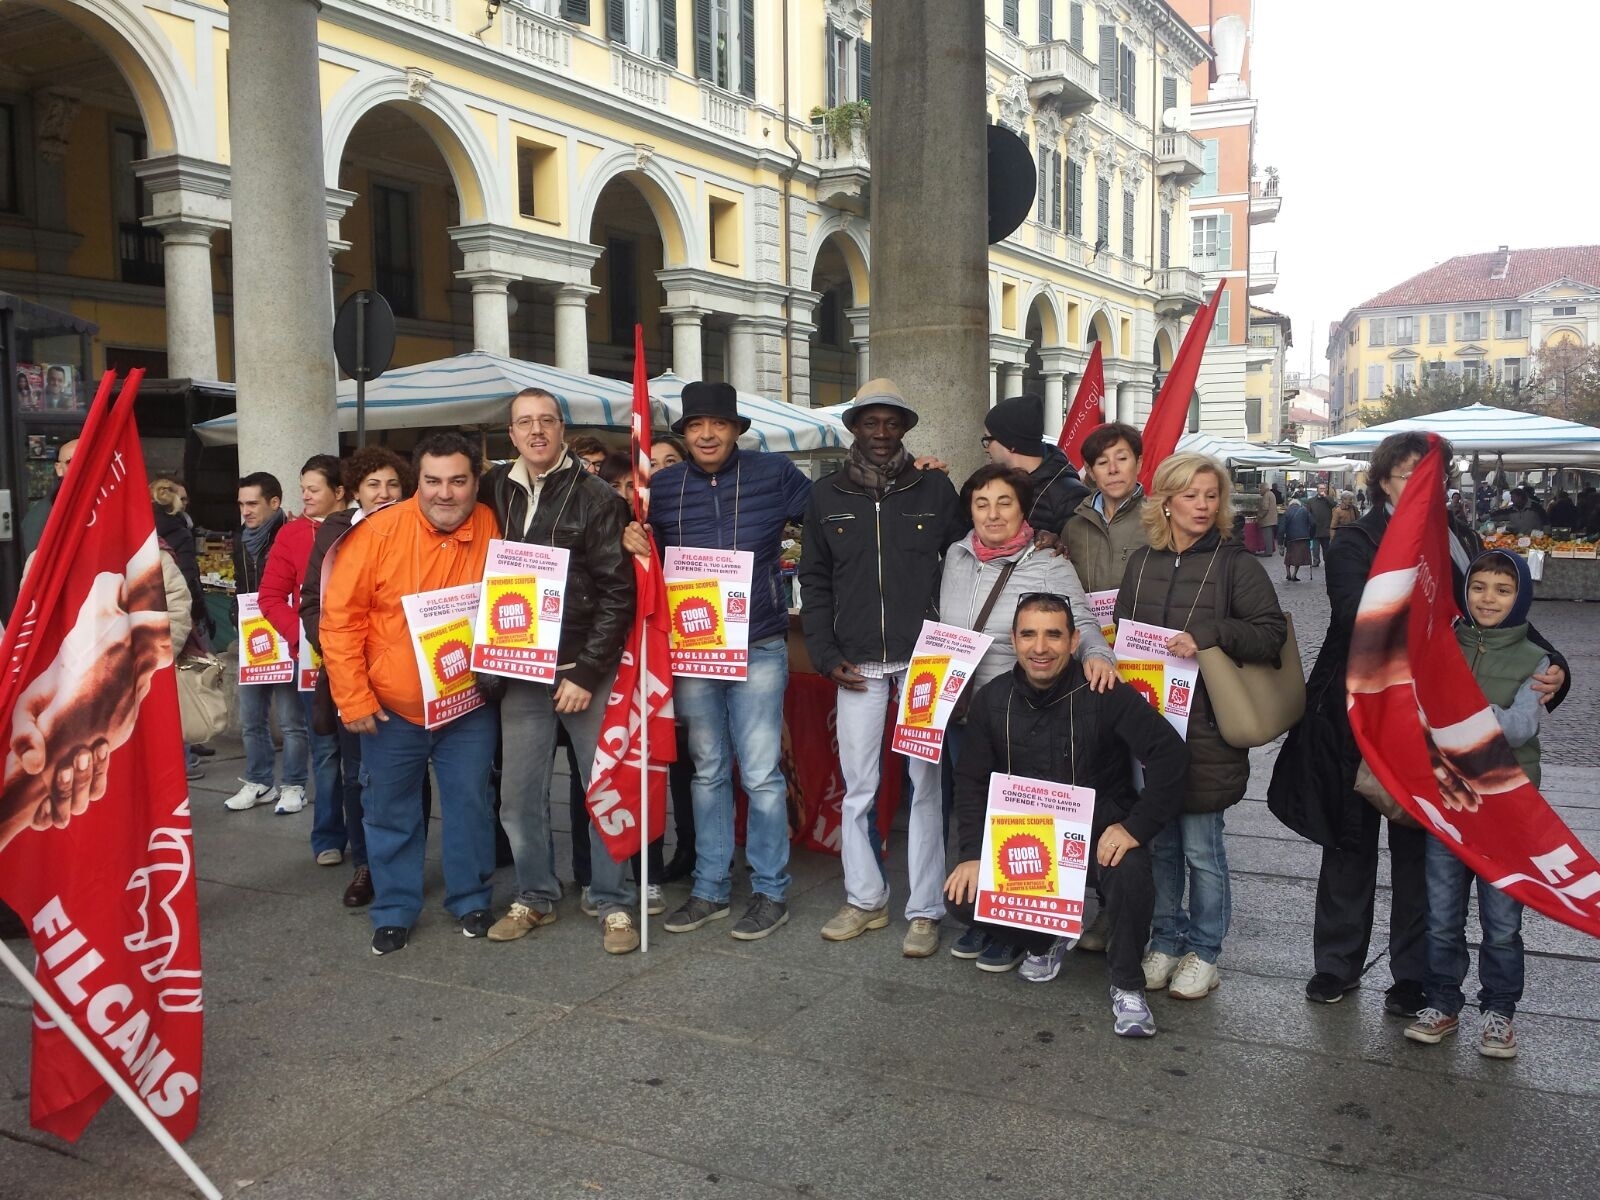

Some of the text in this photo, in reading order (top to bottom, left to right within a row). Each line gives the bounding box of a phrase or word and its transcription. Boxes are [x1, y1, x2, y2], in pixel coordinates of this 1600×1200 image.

[505, 549, 533, 557] FILCAMS
[544, 589, 560, 597] CGIL
[427, 596, 458, 605] FILCAMS
[1095, 598, 1116, 606] FILCA
[420, 604, 449, 613] CONOSCE
[424, 609, 450, 618] DIFENDE
[499, 603, 523, 618] FUORI
[681, 607, 707, 621] FUORI
[499, 616, 526, 629] TUTTI!
[683, 620, 712, 633] TUTTI!
[934, 630, 957, 639] FILCAMS
[1126, 636, 1152, 645] CONOSCE
[1135, 630, 1162, 641] FILCAMS
[1127, 642, 1150, 651] DIFENDE
[441, 648, 464, 668] FUORI
[484, 648, 536, 660] VOGLIAMO
[670, 652, 744, 660] VOGLIAMO IL
[245, 664, 280, 674] VOGLIAMO
[444, 659, 467, 679] TUTTI!
[483, 660, 544, 675] CONTRATTO
[672, 663, 736, 674] CONTRATTO
[952, 670, 966, 678] CGIL
[914, 682, 931, 697] FUORI
[1171, 678, 1190, 688] CGIL
[435, 687, 476, 710] VOGLIAMO
[913, 693, 930, 709] TUTTI!
[436, 698, 480, 720] CONTRATTO
[900, 728, 930, 740] VOGLIAMO
[899, 740, 934, 756] CONTRATTO
[1013, 784, 1071, 799] FILCAMS CGIL
[1003, 790, 1036, 800] CONOSCE
[1058, 799, 1080, 807] LAVORO
[1005, 797, 1035, 806] DIFENDE
[1056, 805, 1077, 813] DIRITTI
[1064, 832, 1086, 841] CGIL
[1008, 846, 1039, 861] FUORI
[1008, 860, 1042, 875] TUTTI!
[1529, 843, 1600, 908] FI
[991, 895, 1080, 913] VOGLIAMO IL
[991, 908, 1068, 929] CONTRATTO
[32, 895, 199, 1117] FILCAMS
